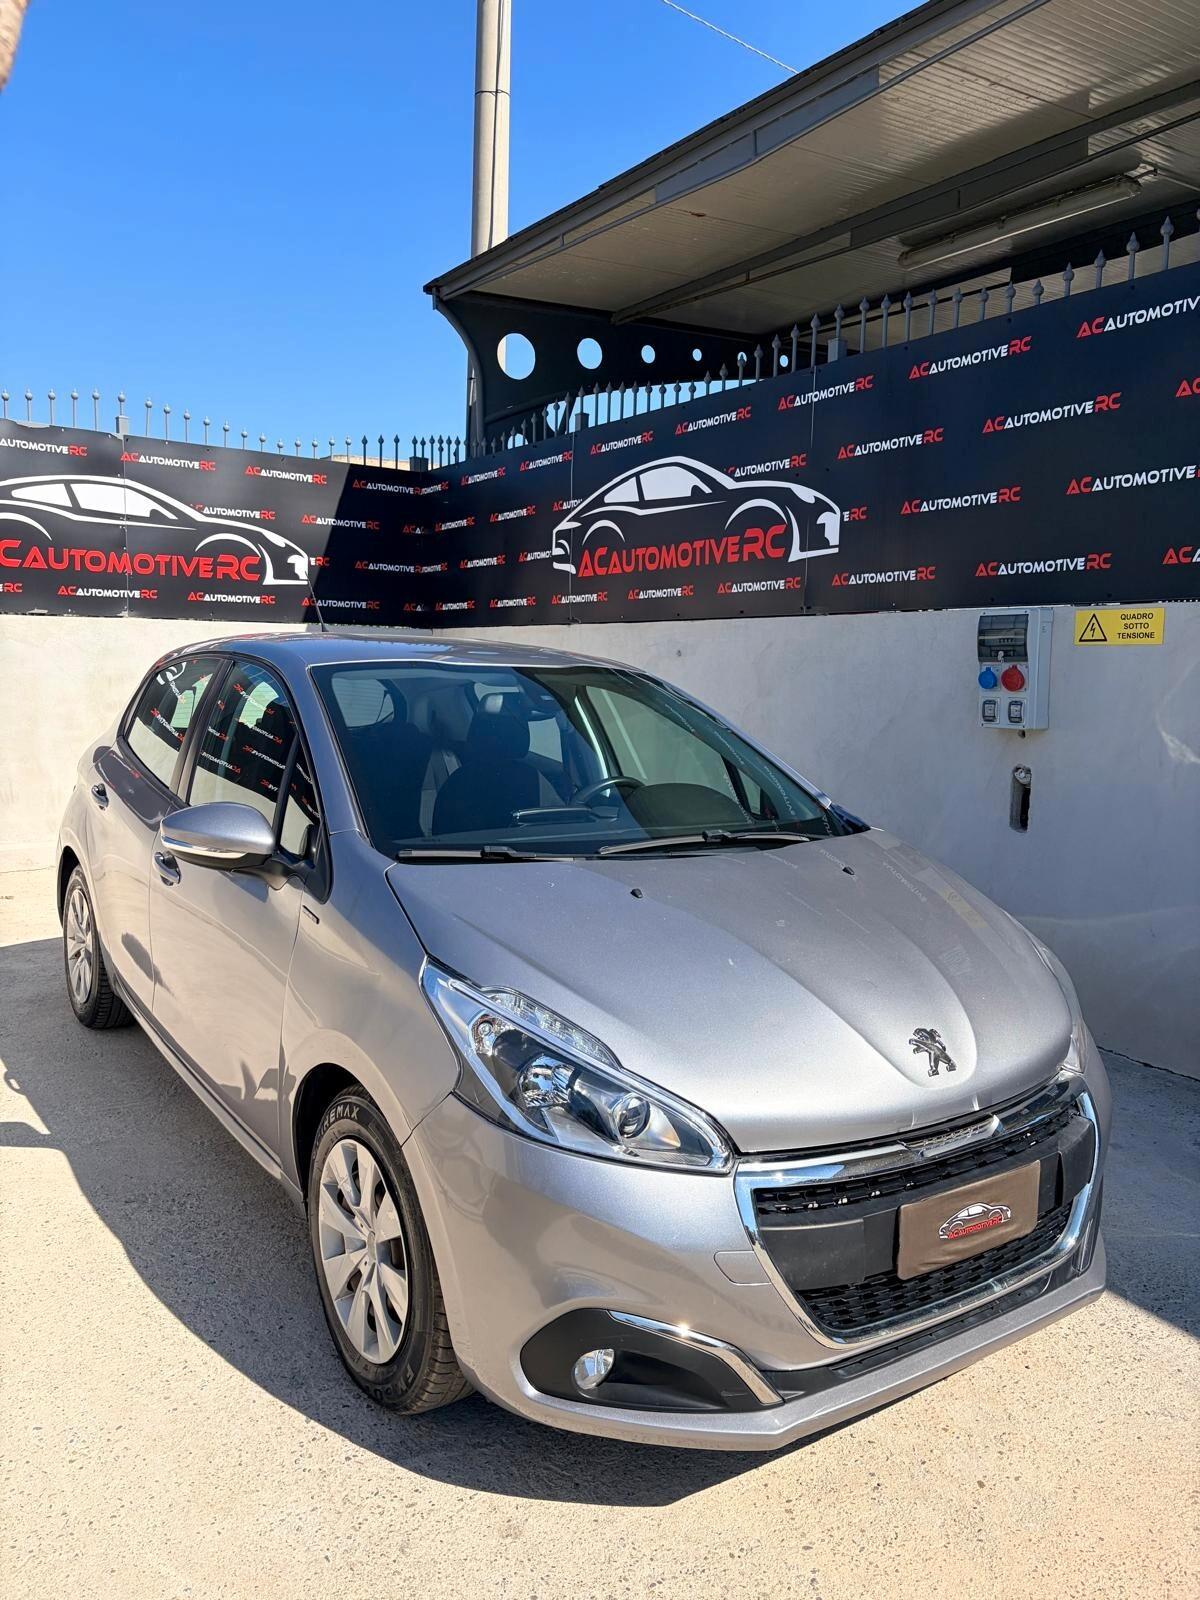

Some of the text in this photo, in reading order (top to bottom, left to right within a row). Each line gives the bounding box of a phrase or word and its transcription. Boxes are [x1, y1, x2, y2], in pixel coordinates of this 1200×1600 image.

[909, 335, 1032, 380] ACAUTOMOTIVERC
[778, 374, 875, 411] ACAUTOMOTIVERC
[675, 406, 752, 436] ACAUTOMOTIVERC
[982, 392, 1122, 433] ACAUTOMOTIVERC
[590, 430, 654, 455] ACAUTOMOTIVERC
[838, 427, 944, 459] ACAUTOMOTIVERC
[120, 451, 216, 471] ACAUTOMOTIVERC
[519, 451, 573, 472] ACAUTOMOTIVERC
[245, 465, 328, 485] ACAUTOMOTIVERC
[460, 467, 506, 487] ACAUTOMOTIVERC
[901, 486, 1021, 515] ACAUTOMOTIVERC
[301, 514, 380, 531] ACAUTOMOTIVERC
[578, 523, 788, 578] ACAUTOMOTIVERC
[975, 552, 1113, 577] ACAUTOMOTIVERC
[717, 576, 801, 594] ACAUTOMOTIVERC
[832, 566, 936, 587] ACAUTOMOTIVERC
[58, 585, 158, 600] ACAUTOMOTIVERC
[188, 591, 276, 605] ACAUTOMOTIVERC
[552, 591, 608, 605] ACAUTOMOTIVERC
[628, 585, 694, 600] ACAUTOMOTIVERC
[301, 597, 380, 610] ACAUTOMOTIVERC
[1120, 613, 1154, 621] QUADRO
[1123, 622, 1150, 630] SOTTO
